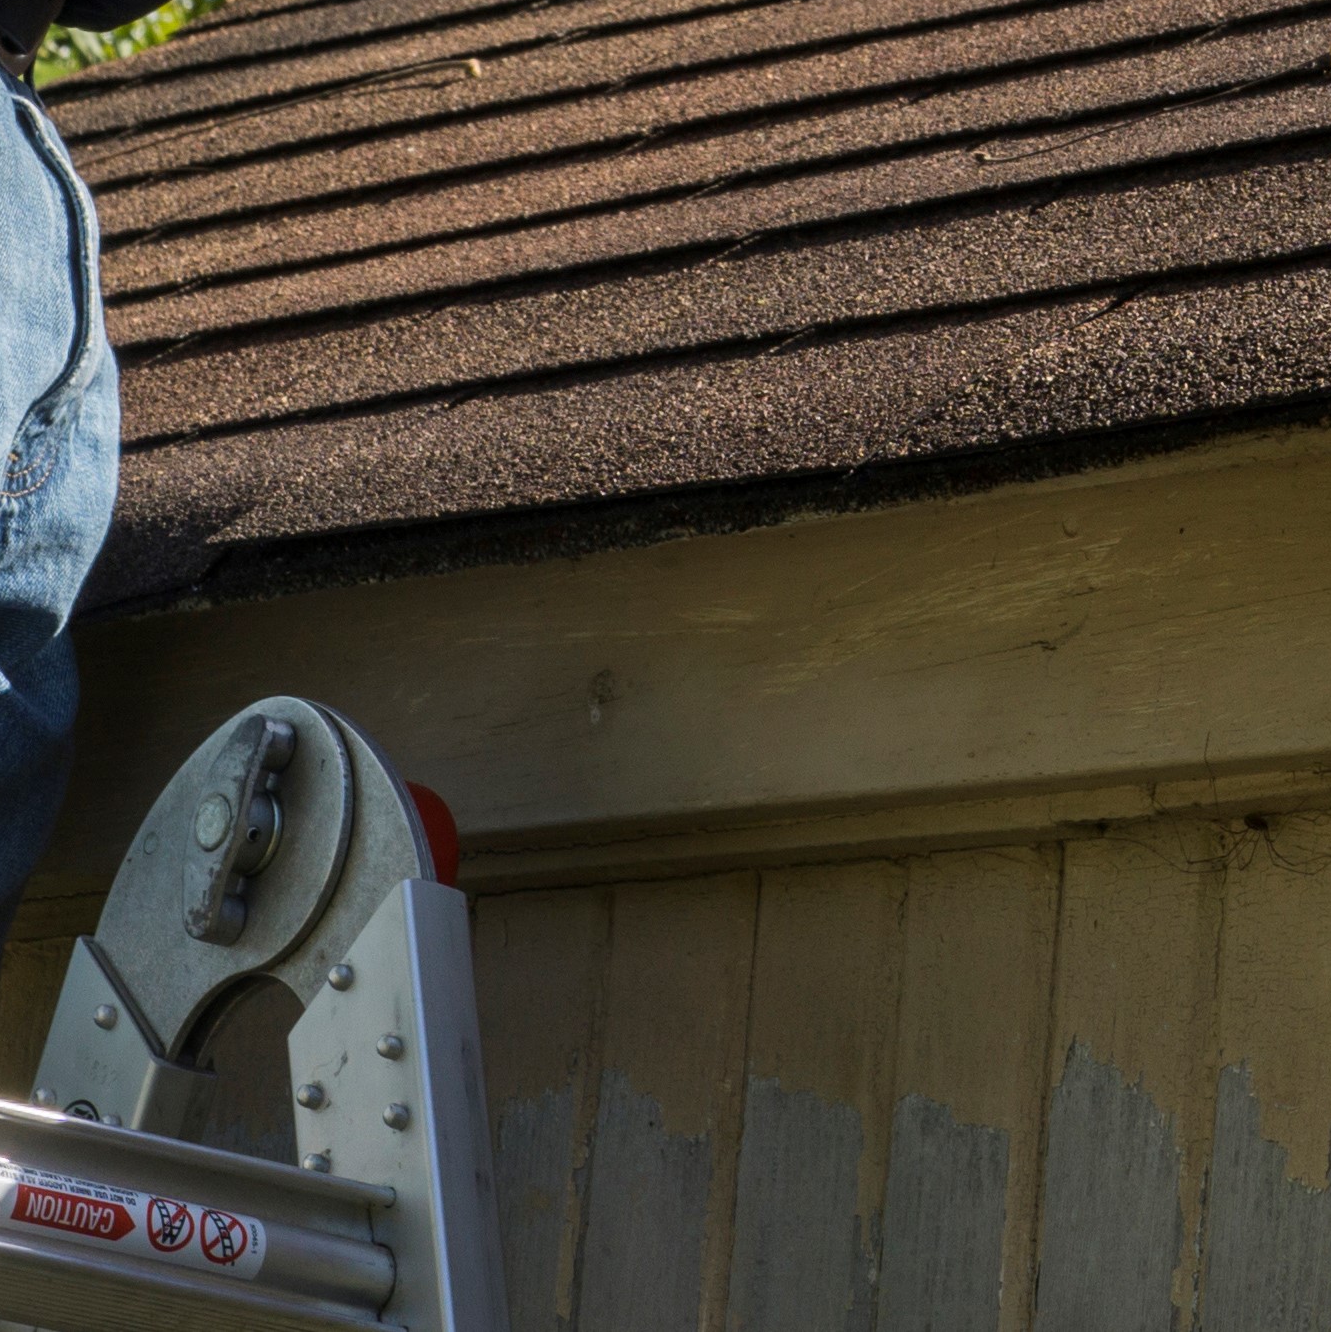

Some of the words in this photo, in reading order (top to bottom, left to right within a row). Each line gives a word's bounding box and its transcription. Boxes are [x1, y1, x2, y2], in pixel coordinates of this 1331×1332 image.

[93, 1189, 109, 1200] USE
[109, 1193, 124, 1204] NOT
[125, 1196, 137, 1206] DO
[25, 1192, 115, 1234] CAUTION
